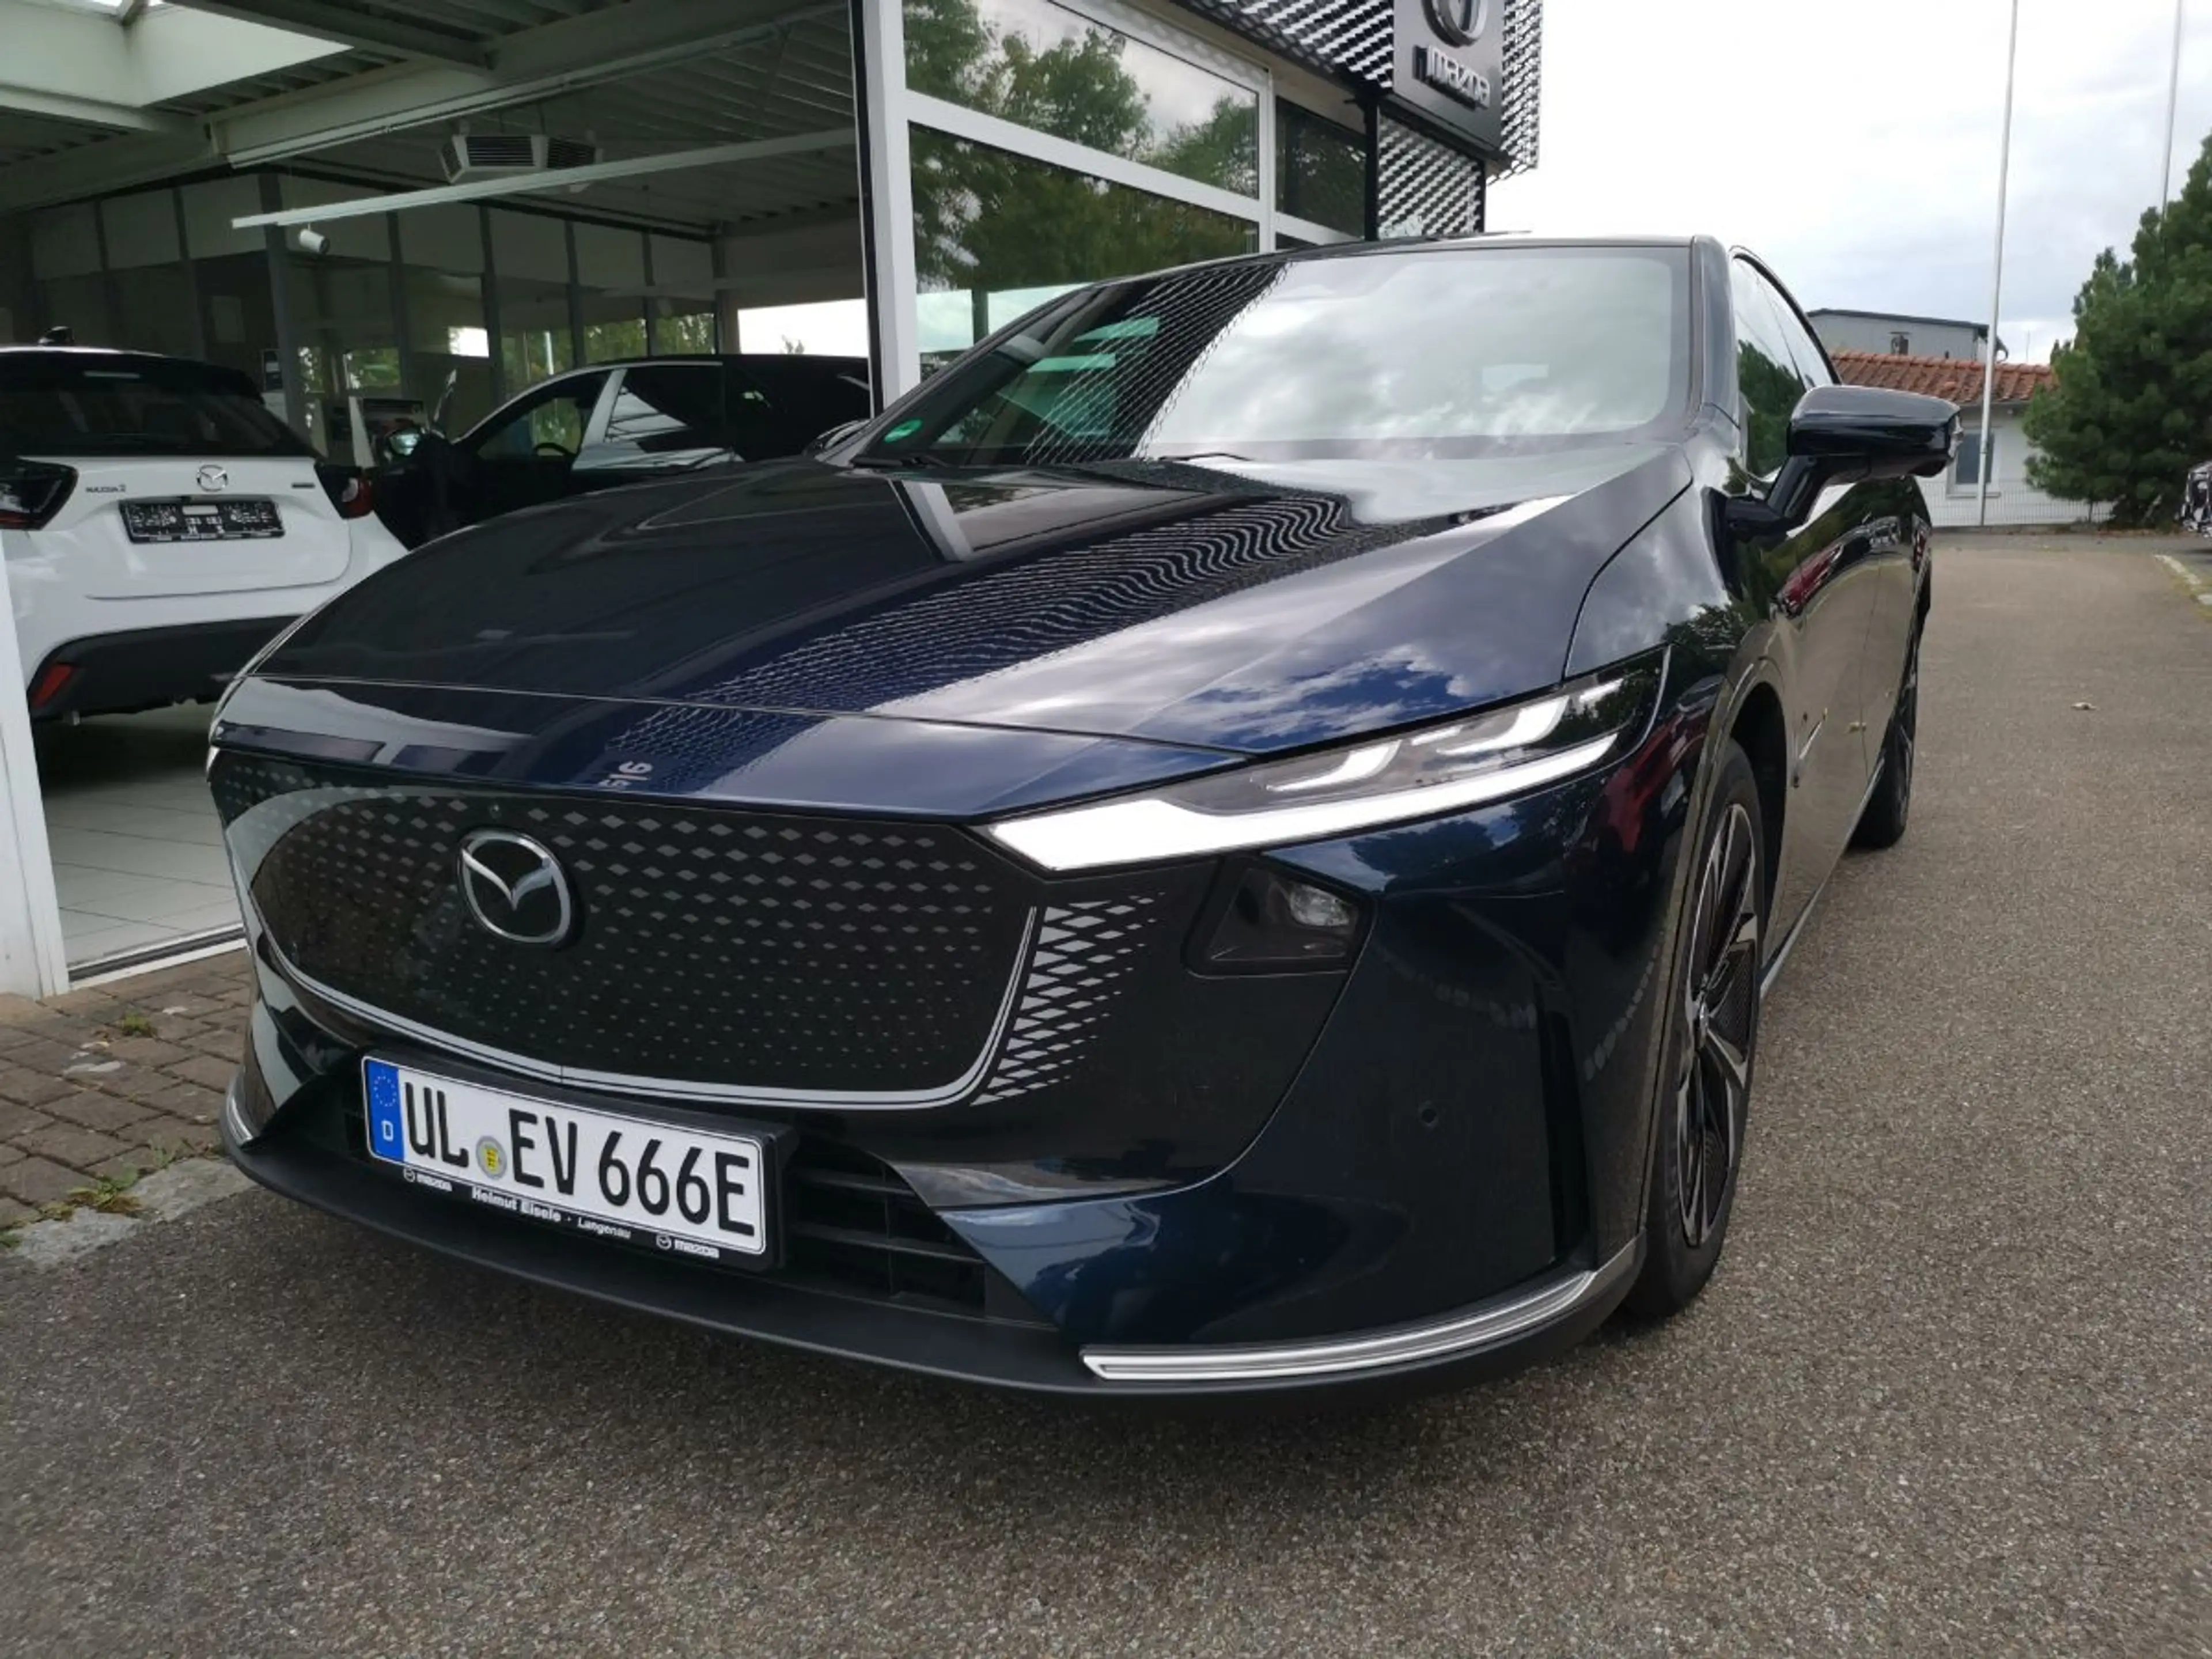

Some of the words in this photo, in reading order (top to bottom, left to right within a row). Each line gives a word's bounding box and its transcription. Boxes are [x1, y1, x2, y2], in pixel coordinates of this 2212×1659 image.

[381, 1120, 393, 1141] D
[405, 1082, 469, 1168] UL
[509, 1108, 578, 1195] EV
[599, 1130, 755, 1237] 666E
[471, 1184, 517, 1210] Helmut
